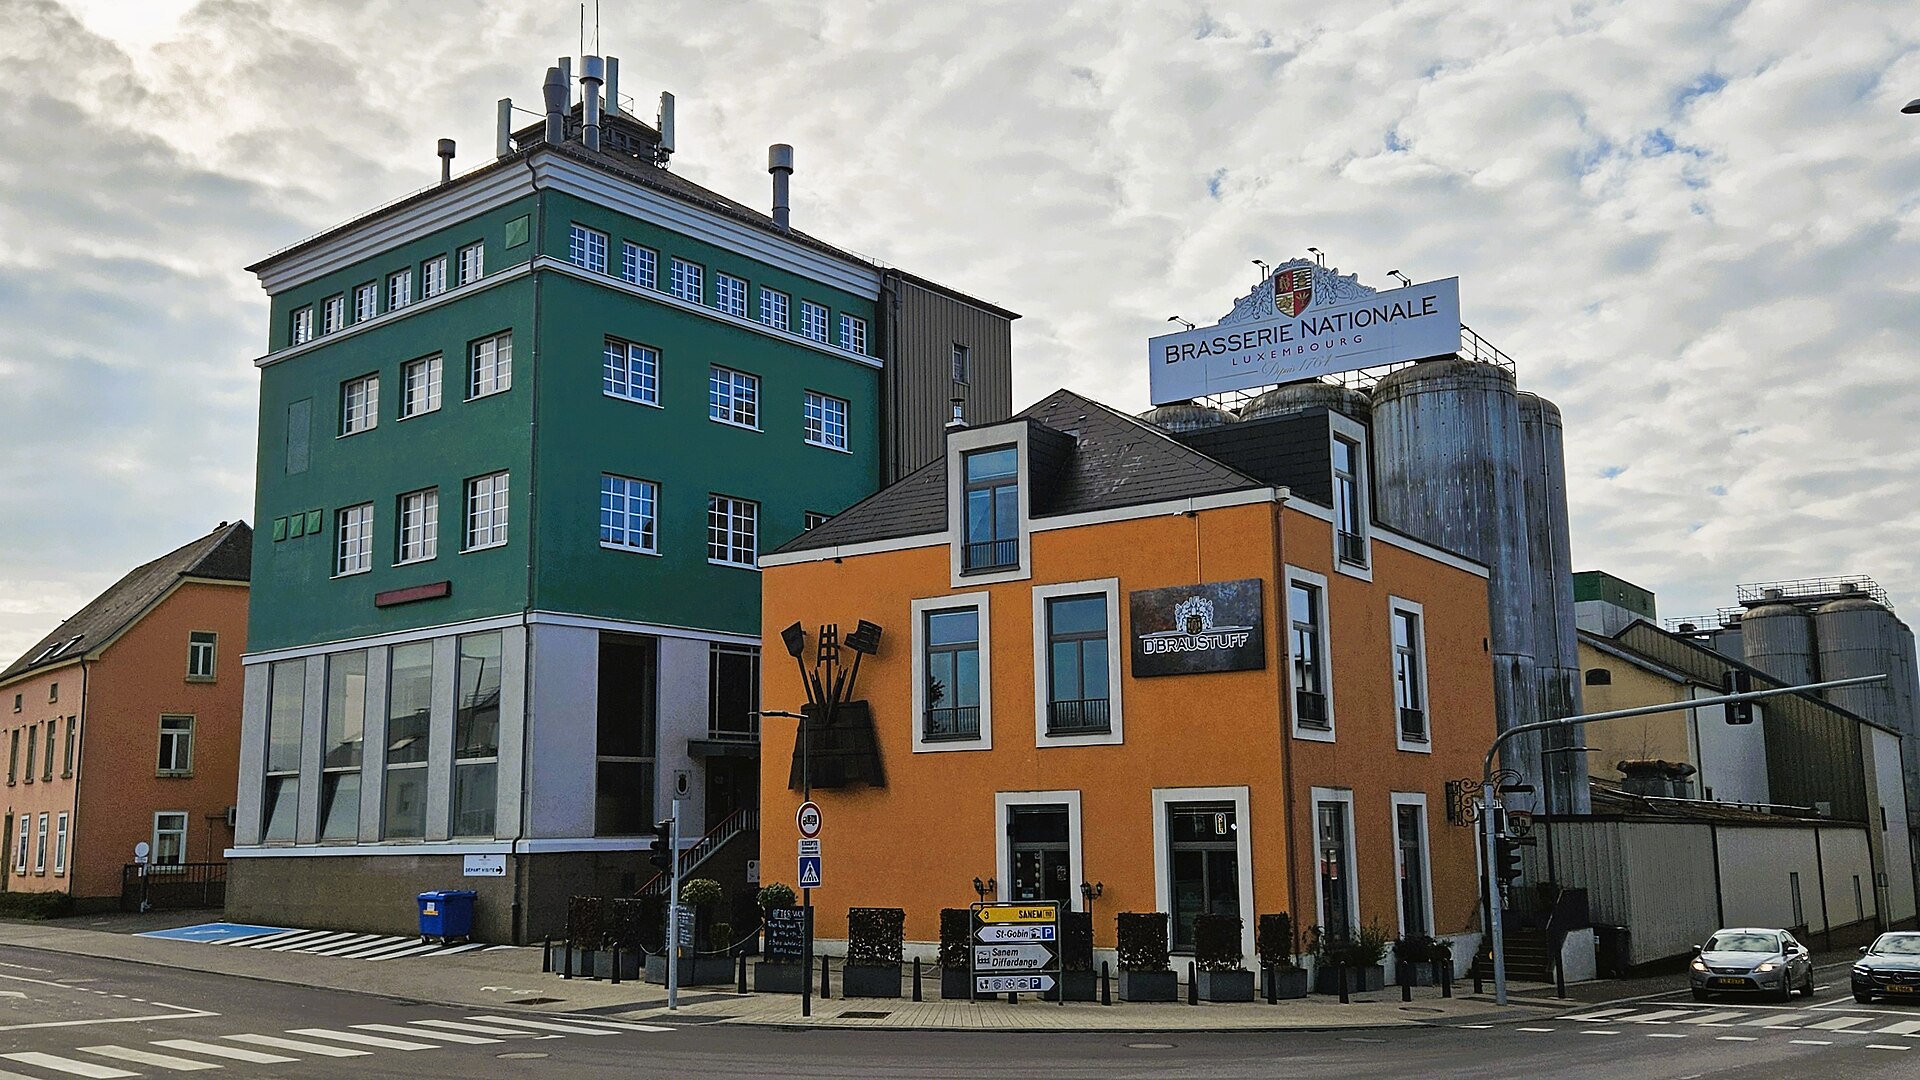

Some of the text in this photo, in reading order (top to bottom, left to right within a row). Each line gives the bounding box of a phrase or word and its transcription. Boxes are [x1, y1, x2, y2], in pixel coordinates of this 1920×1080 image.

[1165, 295, 1438, 365] BRASSERIE NATIONALE
[1232, 334, 1363, 366] LUXEMBOURG
[1143, 633, 1249, 655] D'BRAUSTUFF
[984, 911, 989, 920] 3
[1018, 910, 1042, 918] SANEM
[996, 928, 1051, 938] St-Gobin P
[991, 948, 1019, 956] Sanem
[992, 958, 1038, 968] Differdange
[1032, 979, 1038, 988] P
